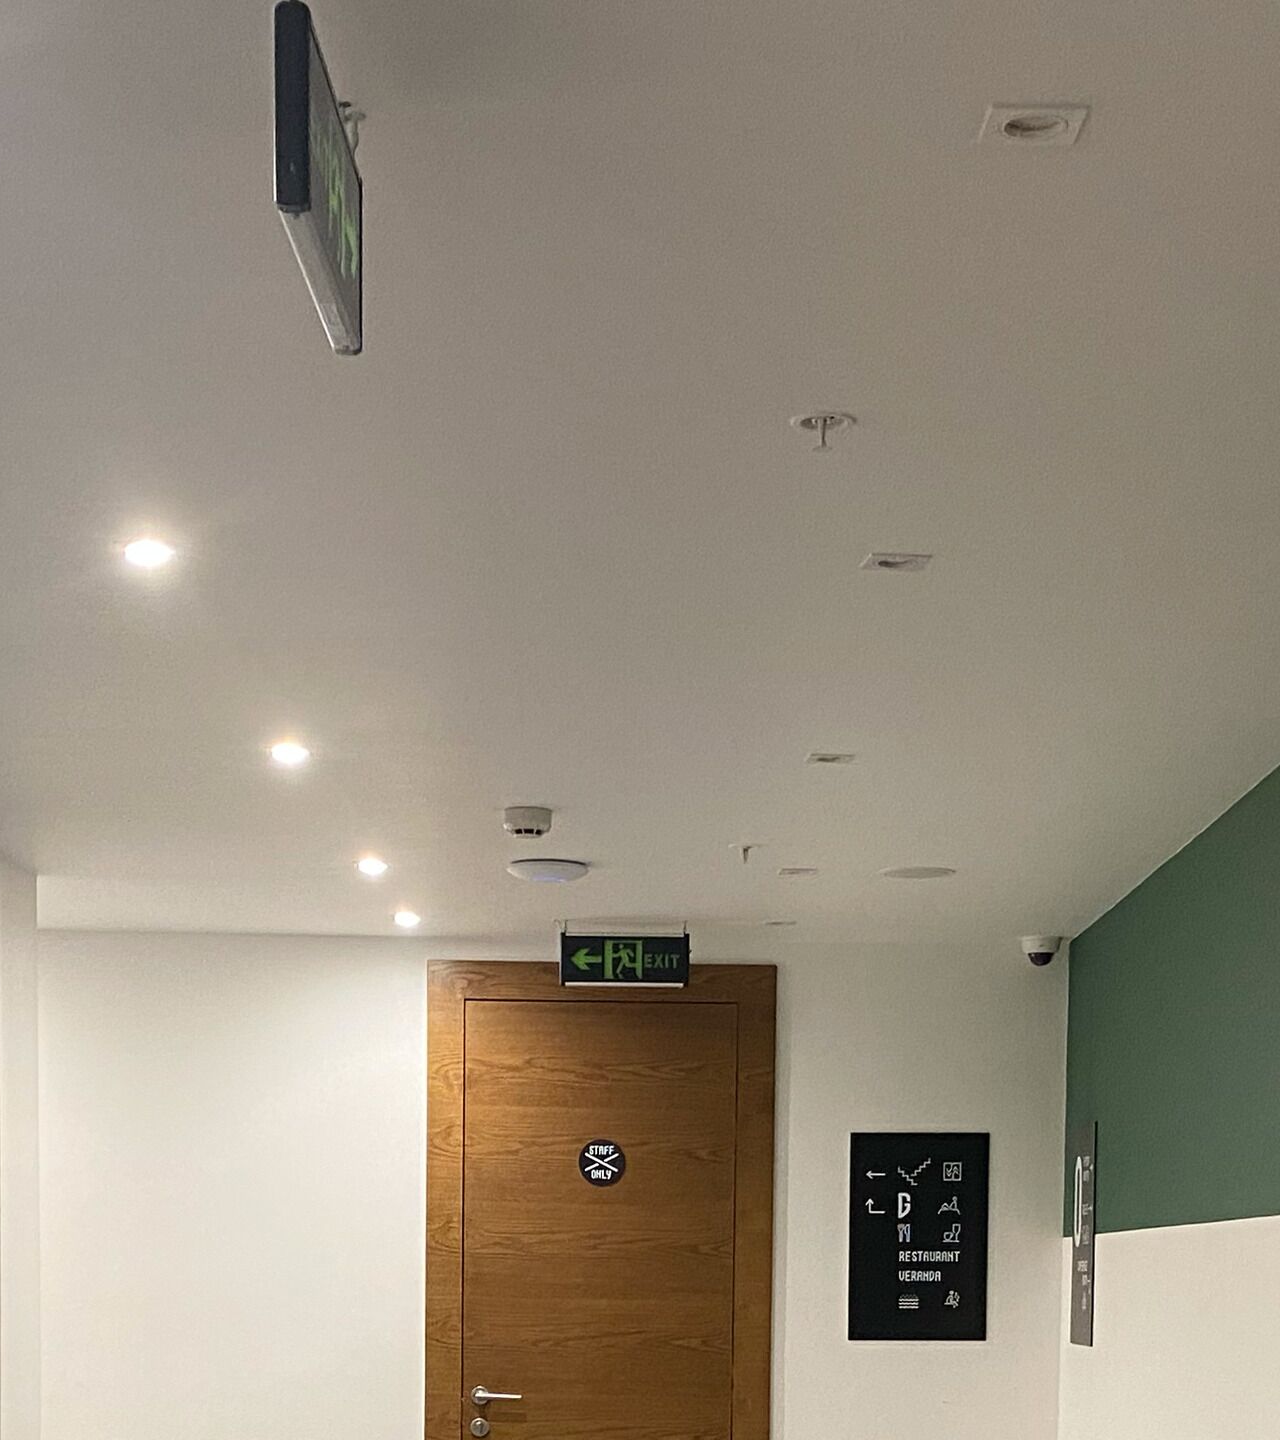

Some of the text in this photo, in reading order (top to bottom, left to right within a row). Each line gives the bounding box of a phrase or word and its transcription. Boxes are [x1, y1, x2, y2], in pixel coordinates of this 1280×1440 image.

[643, 953, 681, 969] EXIT
[588, 1145, 615, 1156] STAFF
[591, 1169, 612, 1180] ONLY
[898, 1250, 960, 1262] RESTAURANT
[898, 1270, 941, 1282] VERANDA
